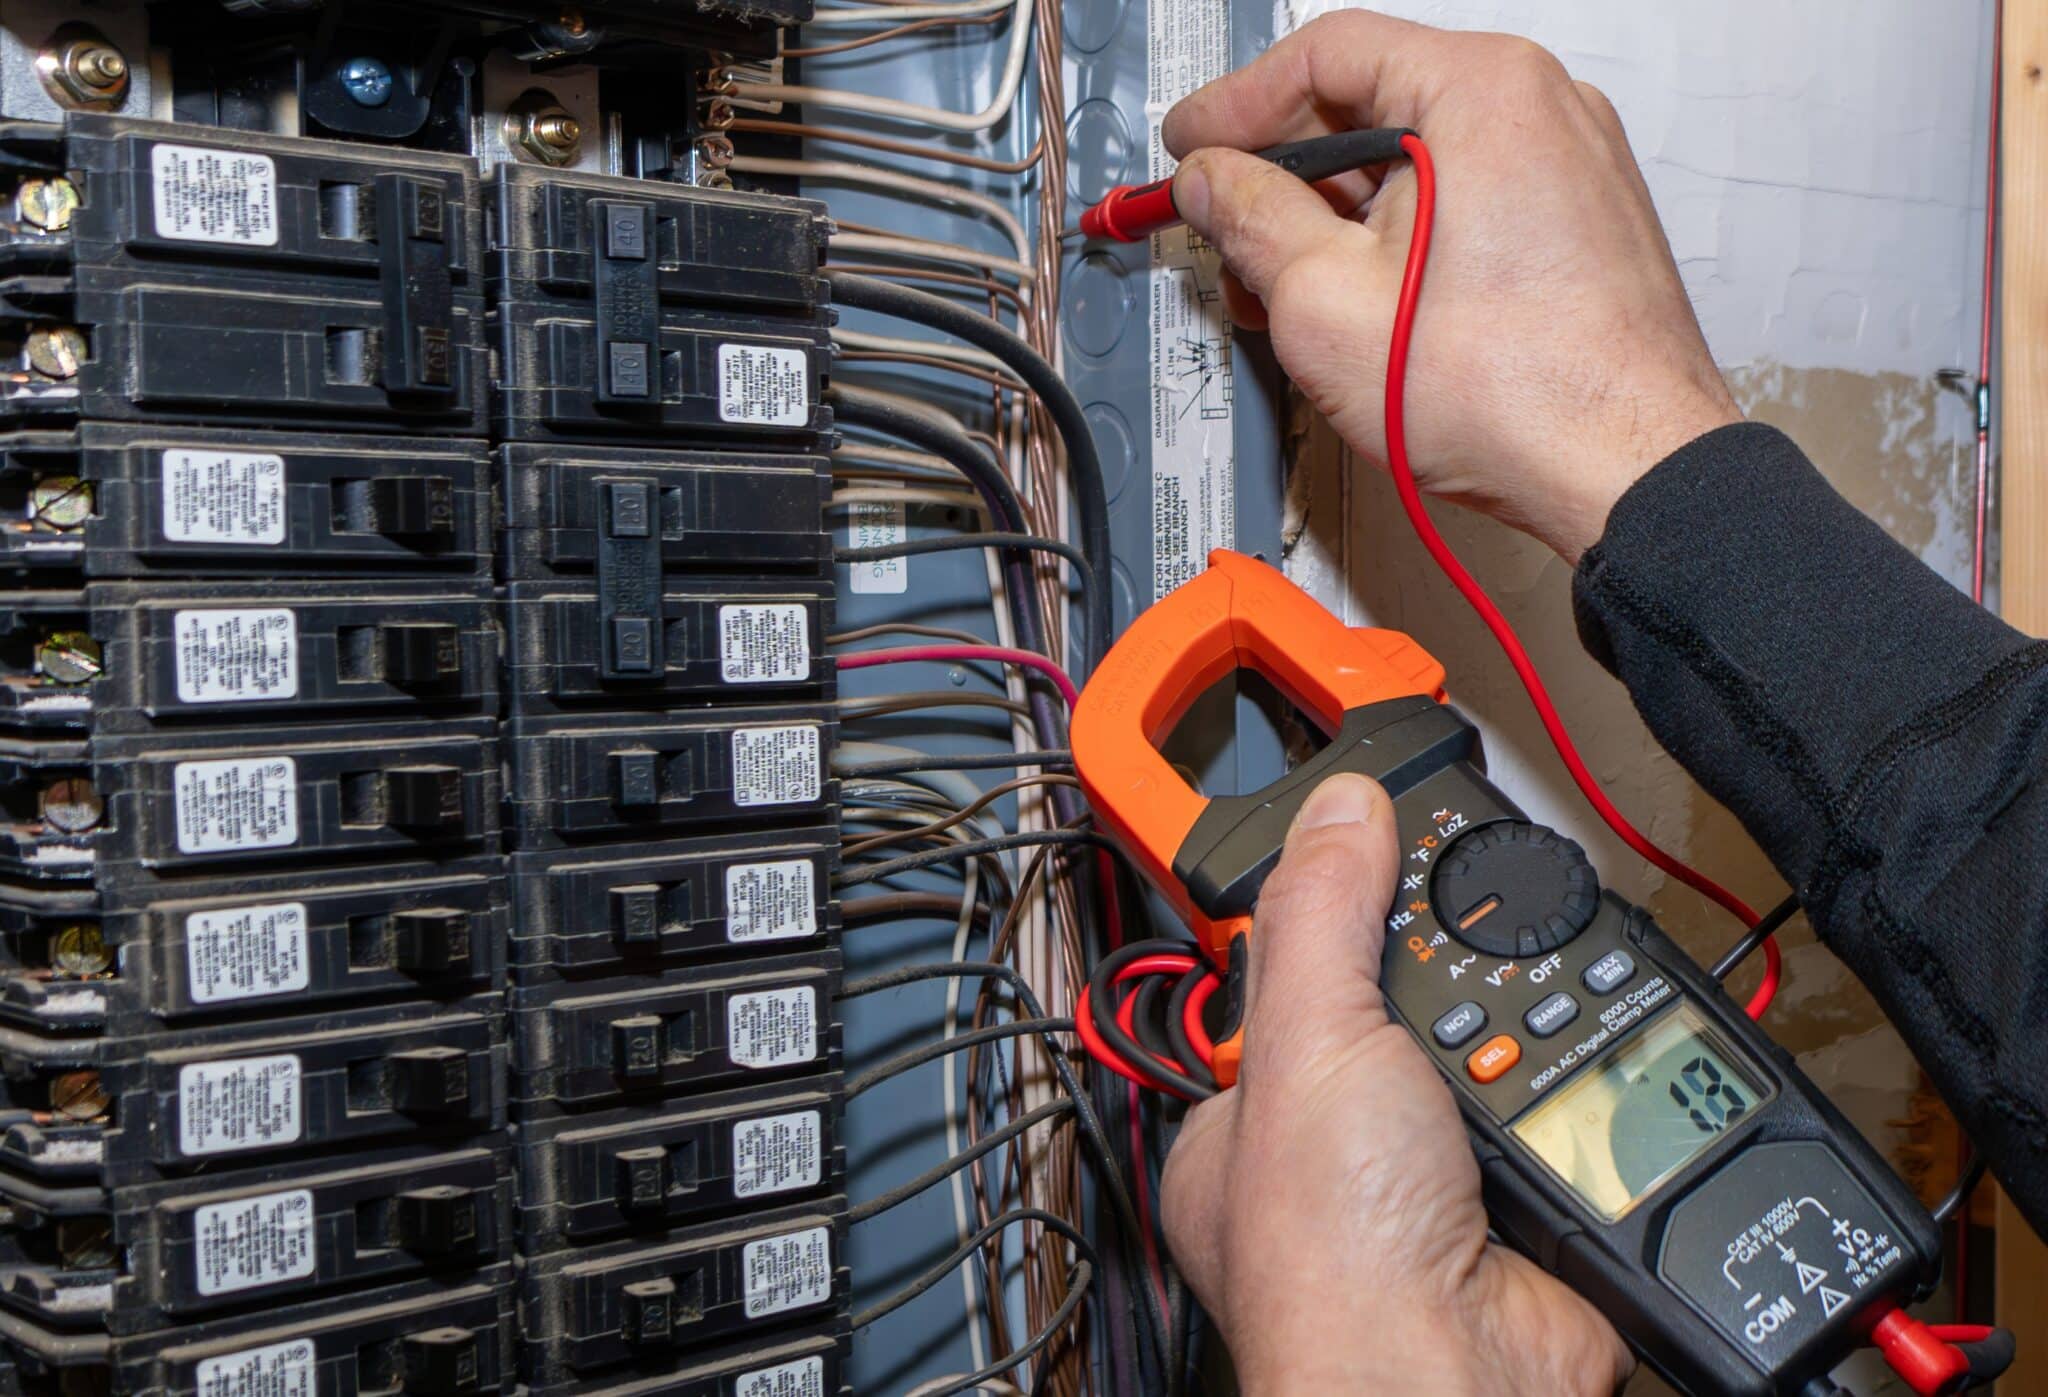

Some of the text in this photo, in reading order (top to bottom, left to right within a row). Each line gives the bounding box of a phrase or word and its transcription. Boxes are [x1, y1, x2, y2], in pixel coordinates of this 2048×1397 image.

[1152, 124, 1160, 152] LUGS
[1155, 536, 1163, 560] USE
[1164, 511, 1172, 576] ALUMINUM
[1155, 563, 1163, 588] FOR
[1438, 813, 1469, 838] LoZ
[1389, 911, 1415, 931] Hz
[1529, 953, 1563, 983] OFF
[1592, 956, 1619, 978] MAX
[1602, 963, 1625, 984] MIN
[1532, 997, 1571, 1028] RANGE
[1600, 976, 1664, 1023] 6000 Counts
[1444, 1010, 1471, 1035] NCV
[1530, 984, 1672, 1091] 600A AC Digital Clamp Meter
[1480, 1046, 1507, 1068] SEL
[1727, 1233, 1753, 1257] CAT
[1761, 1197, 1794, 1227] 1000V
[1738, 1240, 1764, 1264] CAT
[1773, 1209, 1801, 1236] 600V
[1745, 1295, 1796, 1344] COM
